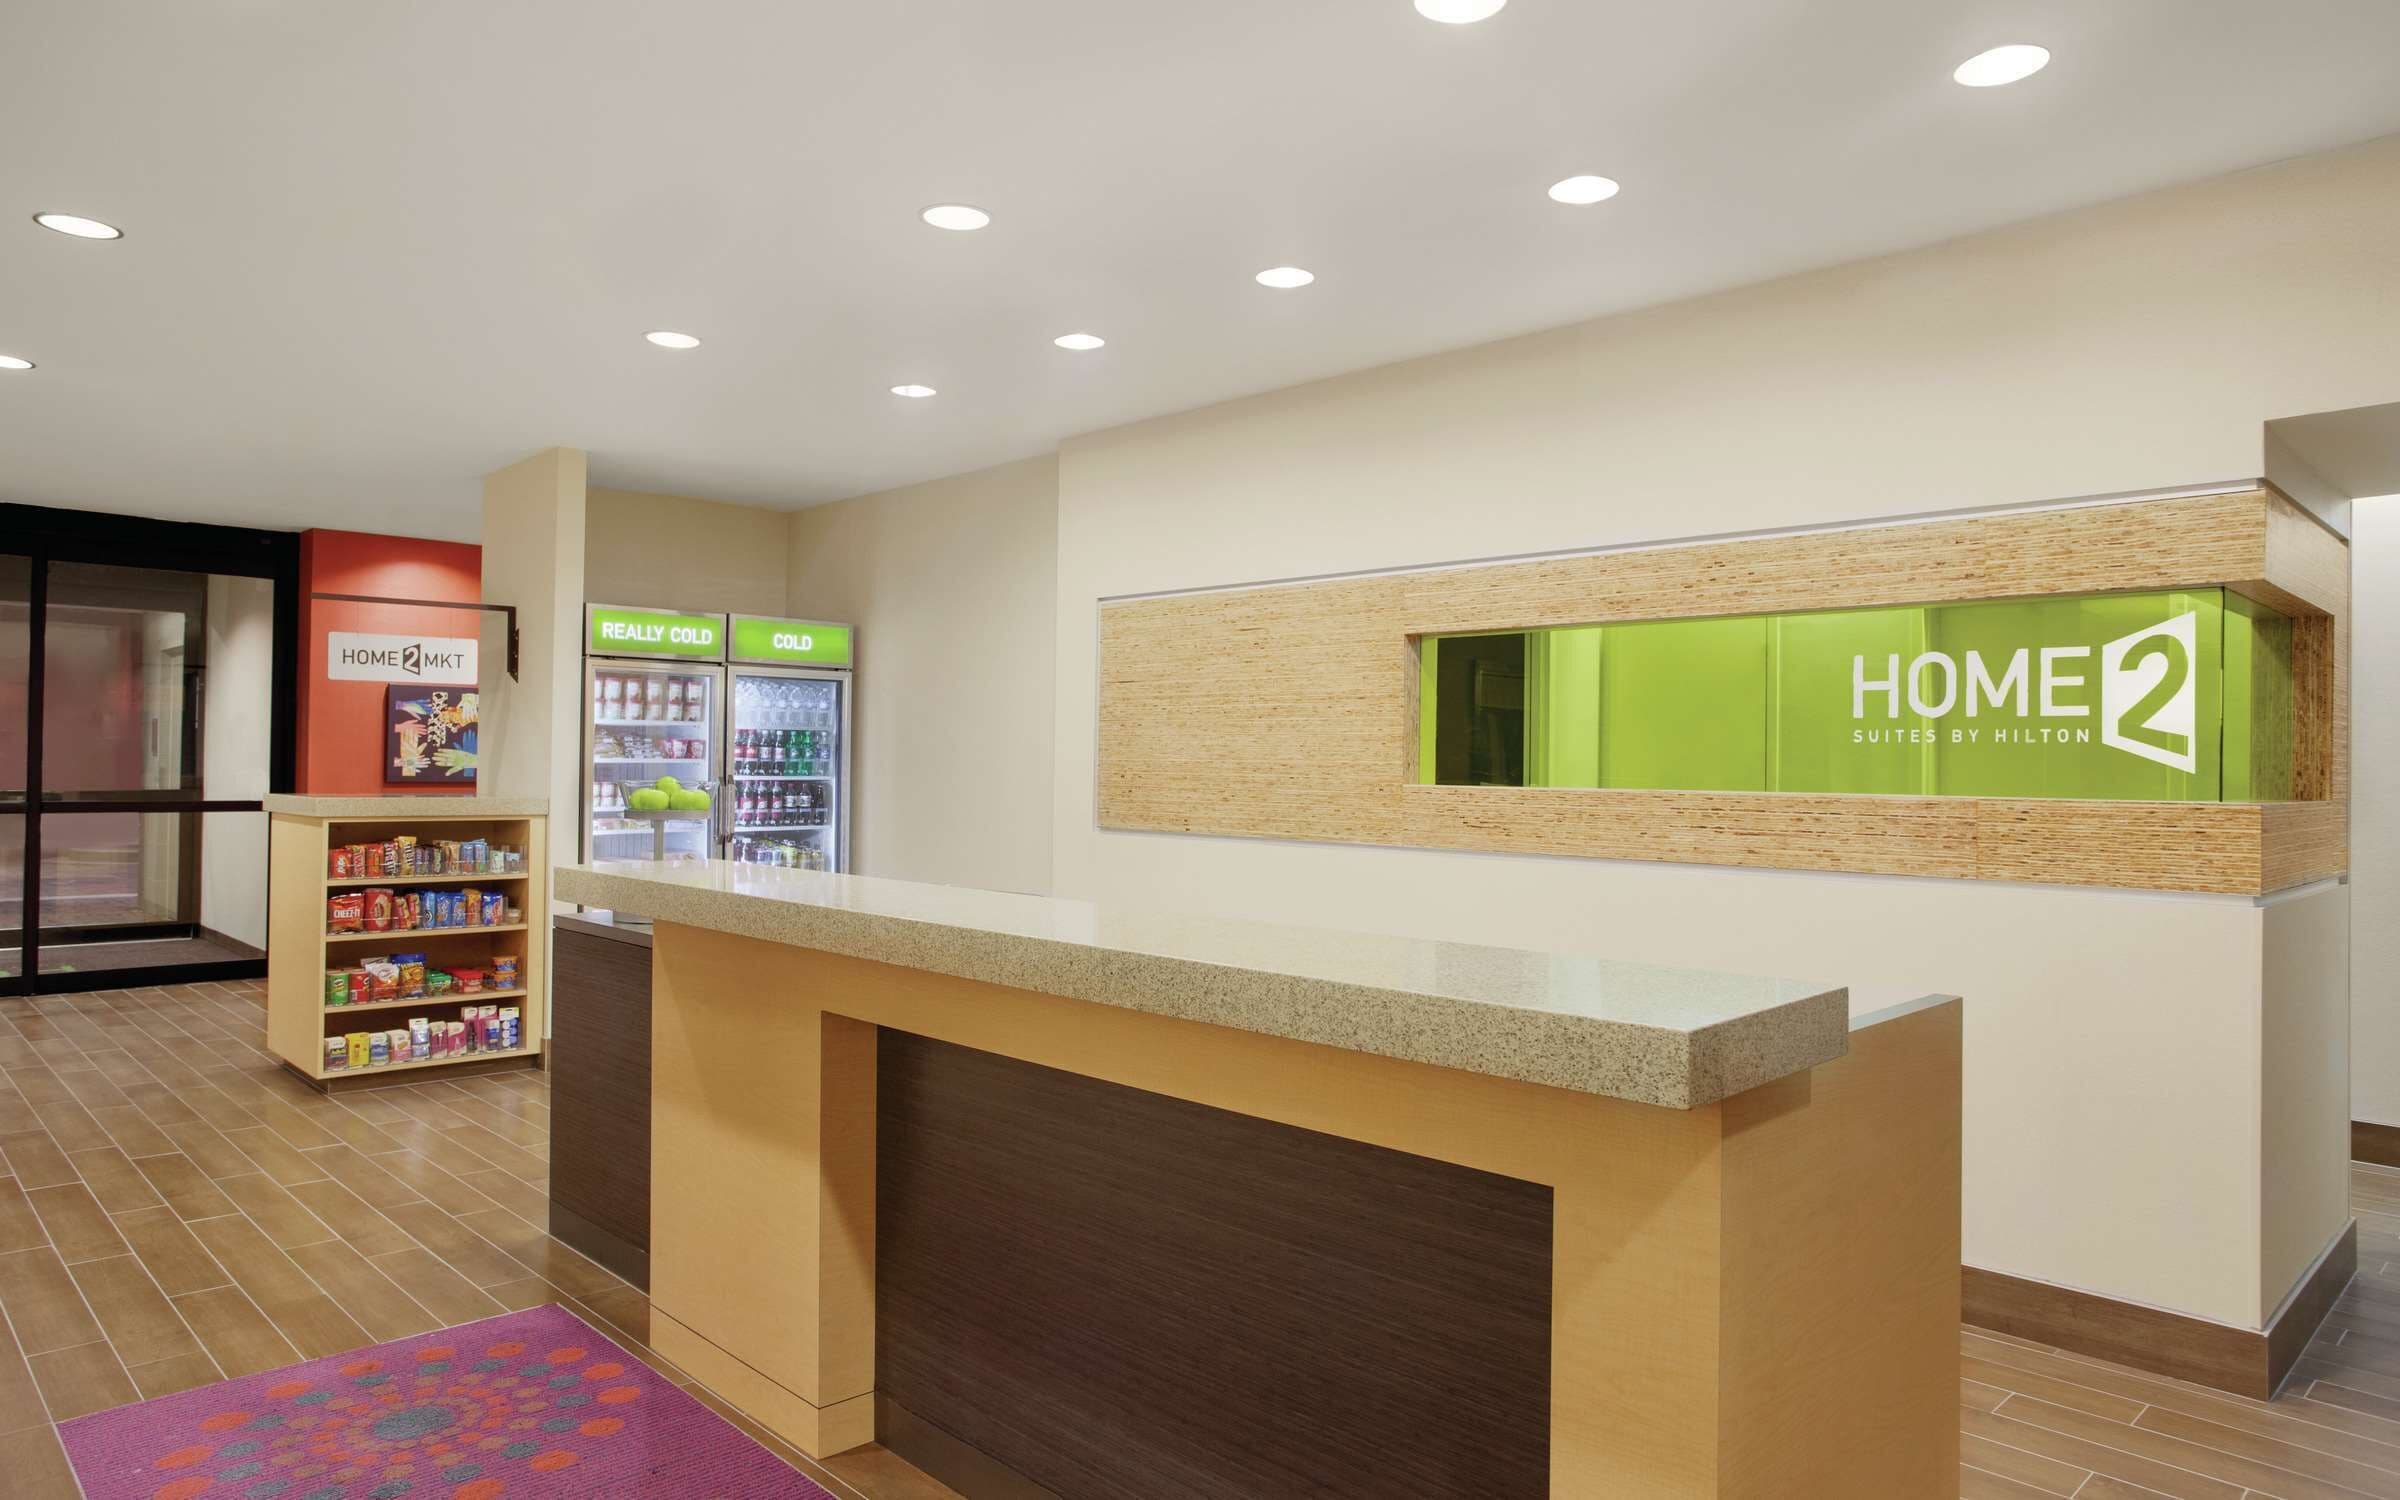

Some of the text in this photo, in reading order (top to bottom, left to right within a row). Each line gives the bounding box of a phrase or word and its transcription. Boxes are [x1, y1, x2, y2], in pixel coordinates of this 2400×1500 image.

[601, 622, 713, 645] REALLY COLD
[773, 633, 812, 651] COLD
[1852, 633, 2190, 757] HOME 2
[1853, 728, 2090, 744] SUITES BY HILTON
